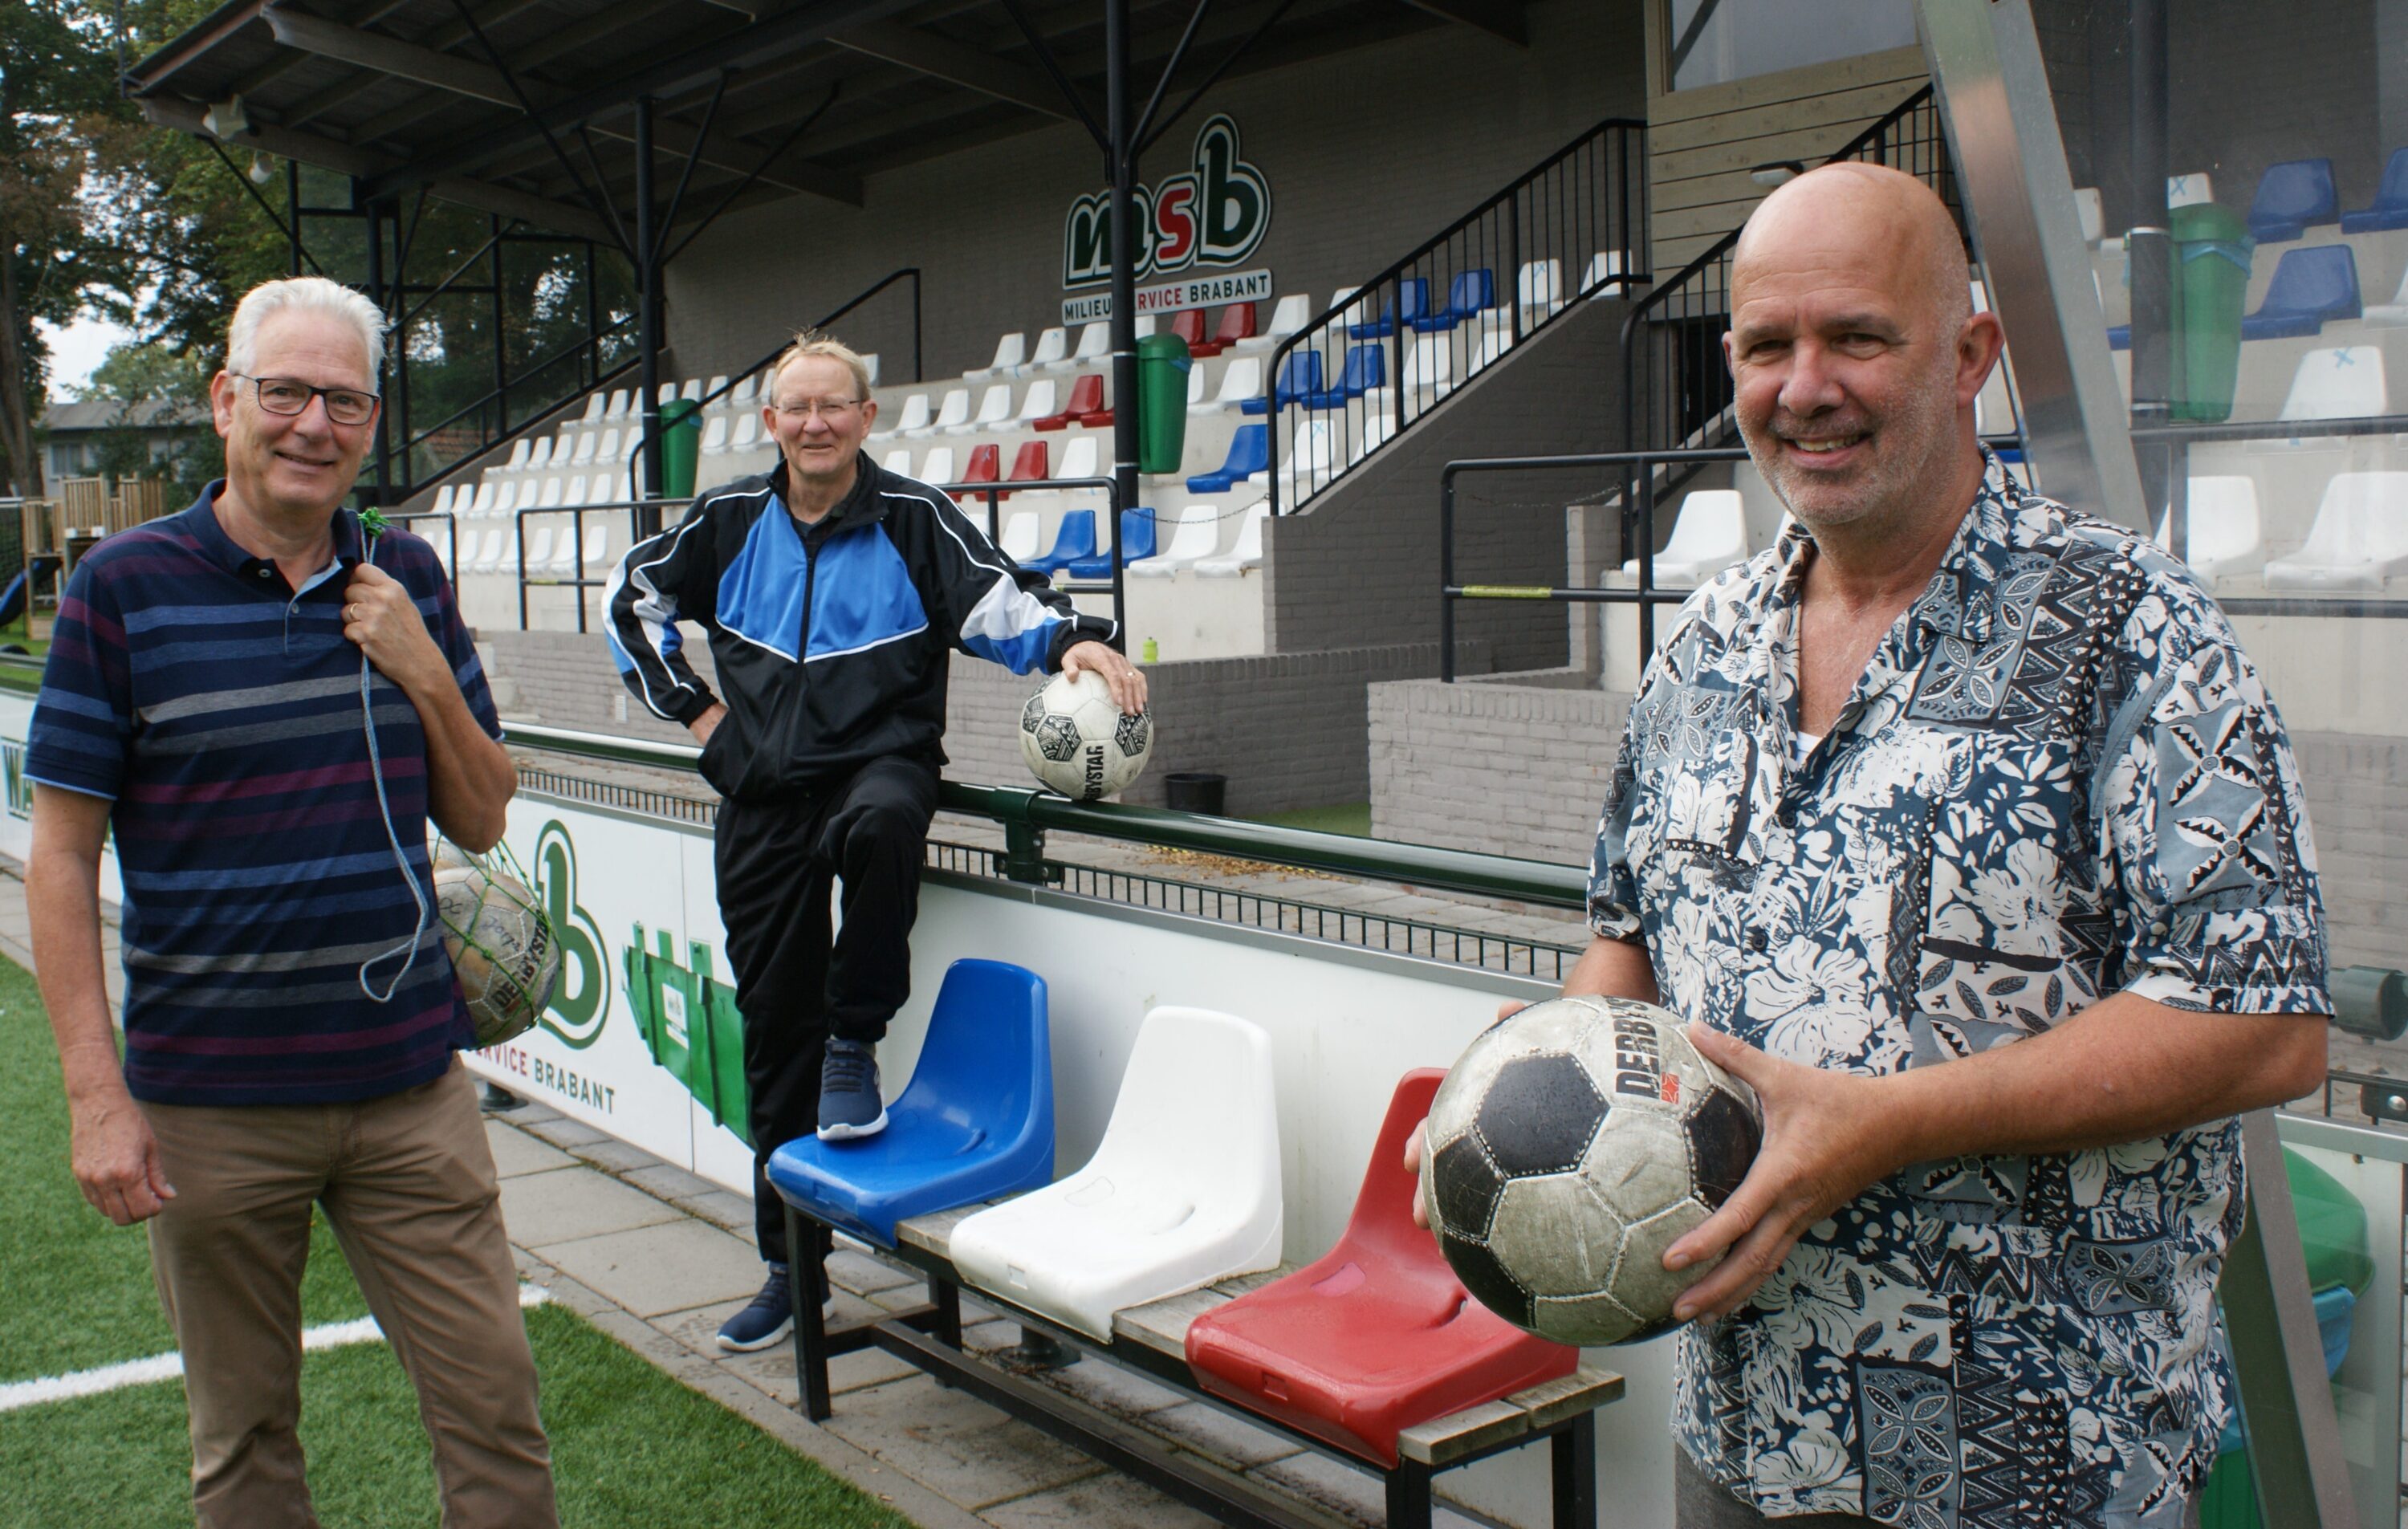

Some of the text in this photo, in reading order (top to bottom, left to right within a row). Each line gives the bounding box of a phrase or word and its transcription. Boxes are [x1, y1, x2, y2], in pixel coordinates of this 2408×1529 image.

[1064, 274, 1268, 320] MILIEU RVICE BRABANT
[534, 1057, 616, 1115] BRABANT
